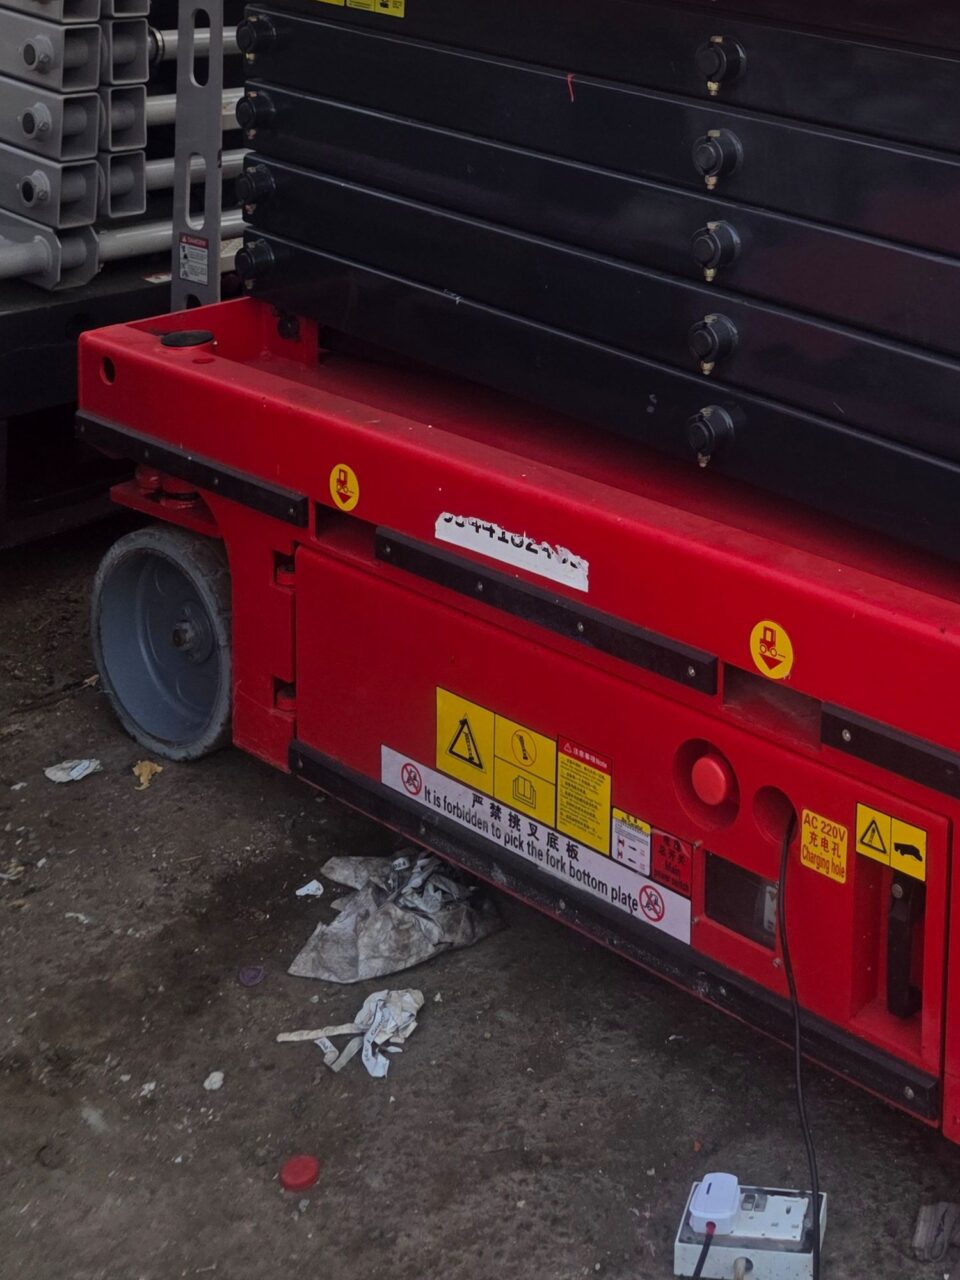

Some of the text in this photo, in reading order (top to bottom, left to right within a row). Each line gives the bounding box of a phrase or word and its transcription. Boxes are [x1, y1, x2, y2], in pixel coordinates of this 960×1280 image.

[471, 792, 581, 863] 严禁挑叉底板
[804, 813, 846, 842] AC 220V
[424, 785, 432, 805] It
[433, 789, 441, 809] is
[443, 794, 489, 831] forbidden
[491, 819, 502, 840] to
[503, 826, 524, 853] pick
[527, 838, 544, 861] the
[546, 848, 567, 876] fork
[569, 859, 608, 897] bottom
[611, 880, 638, 913] plate
[802, 844, 845, 878] Charging hole
[808, 831, 841, 859] 充电孔
